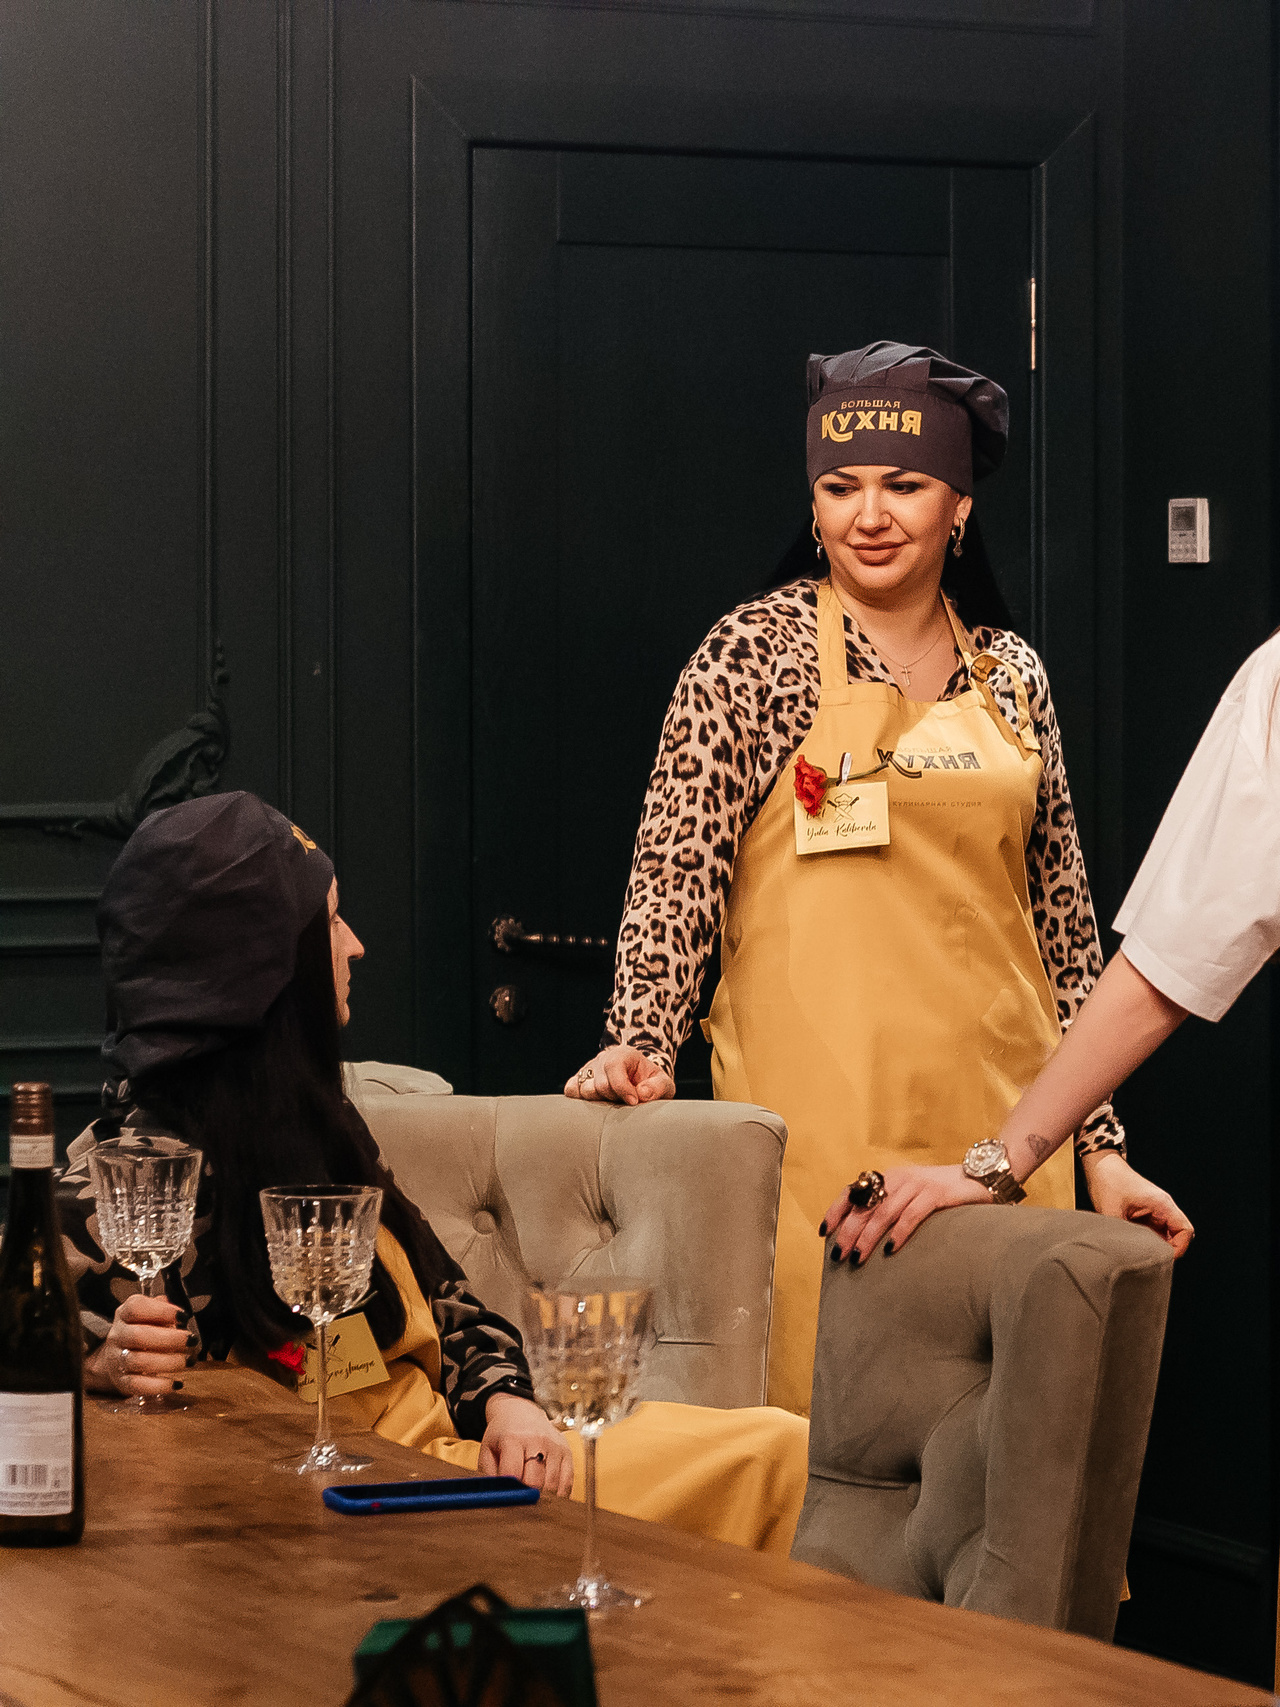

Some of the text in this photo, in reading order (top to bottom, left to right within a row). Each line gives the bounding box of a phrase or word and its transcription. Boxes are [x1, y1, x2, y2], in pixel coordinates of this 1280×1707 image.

[841, 400, 901, 410] БОЛЬШАЯ
[821, 409, 922, 442] КУХНЯ
[876, 748, 981, 779] КУХНЯ
